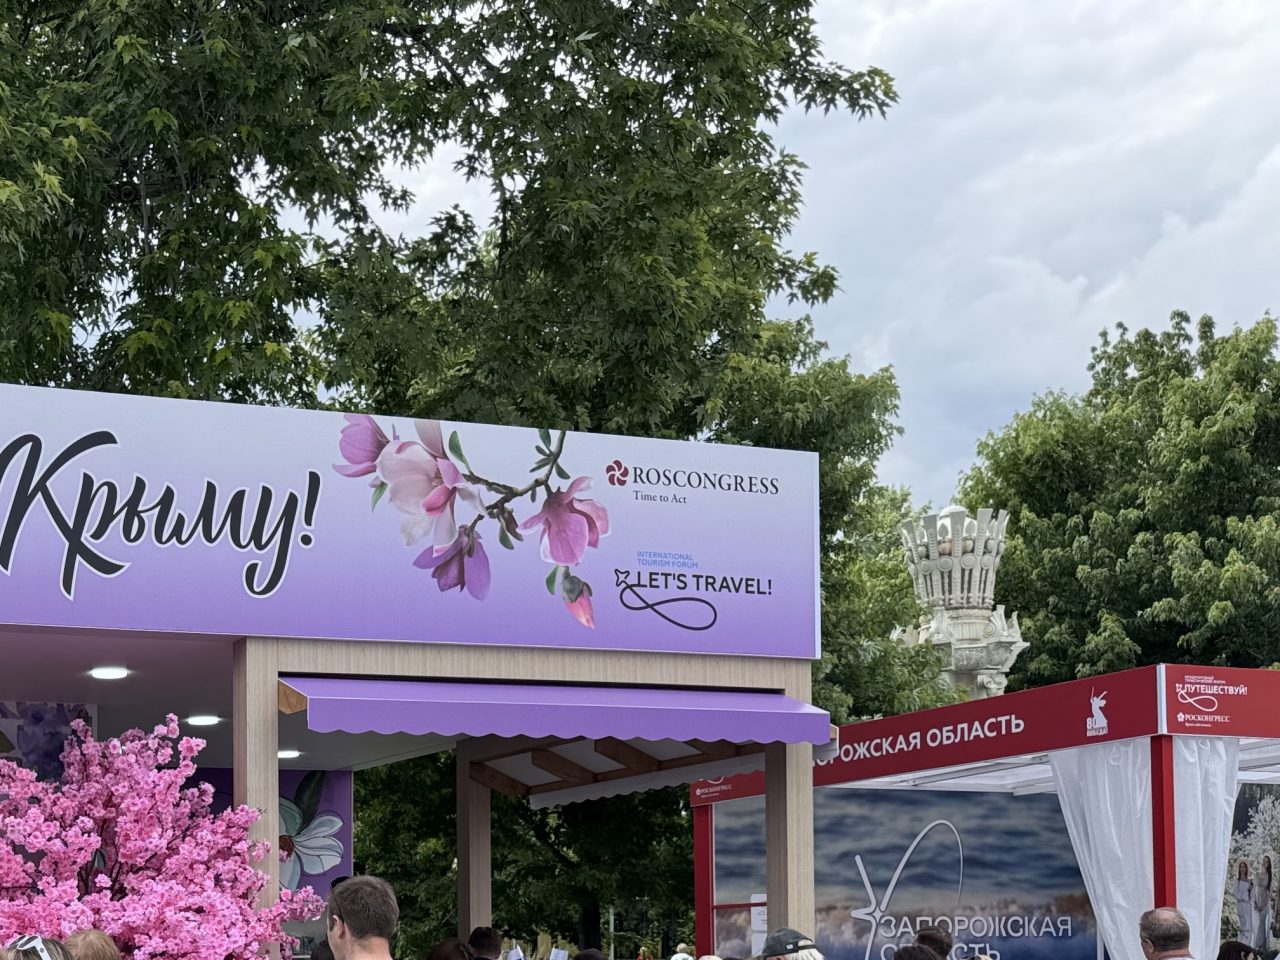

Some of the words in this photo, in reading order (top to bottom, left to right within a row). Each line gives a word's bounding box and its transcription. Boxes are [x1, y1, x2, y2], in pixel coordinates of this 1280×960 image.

[632, 466, 779, 495] ROSCONGRESS
[633, 490, 658, 502] Time
[660, 494, 669, 503] to
[671, 494, 687, 504] Act
[636, 551, 694, 561] INTERNATIONAL
[637, 559, 671, 567] TOURISM
[672, 561, 699, 569] FORUM
[636, 571, 688, 591] LET'S
[692, 574, 772, 595] TRAVEL!
[1184, 684, 1248, 695] ПУТЕШЕСТВУЙ!
[813, 731, 921, 767] ОЖСКАЯ
[926, 714, 1025, 747] ОБЛАСТЬ
[880, 916, 1072, 937] ЗАПОРОЖСКАЯ
